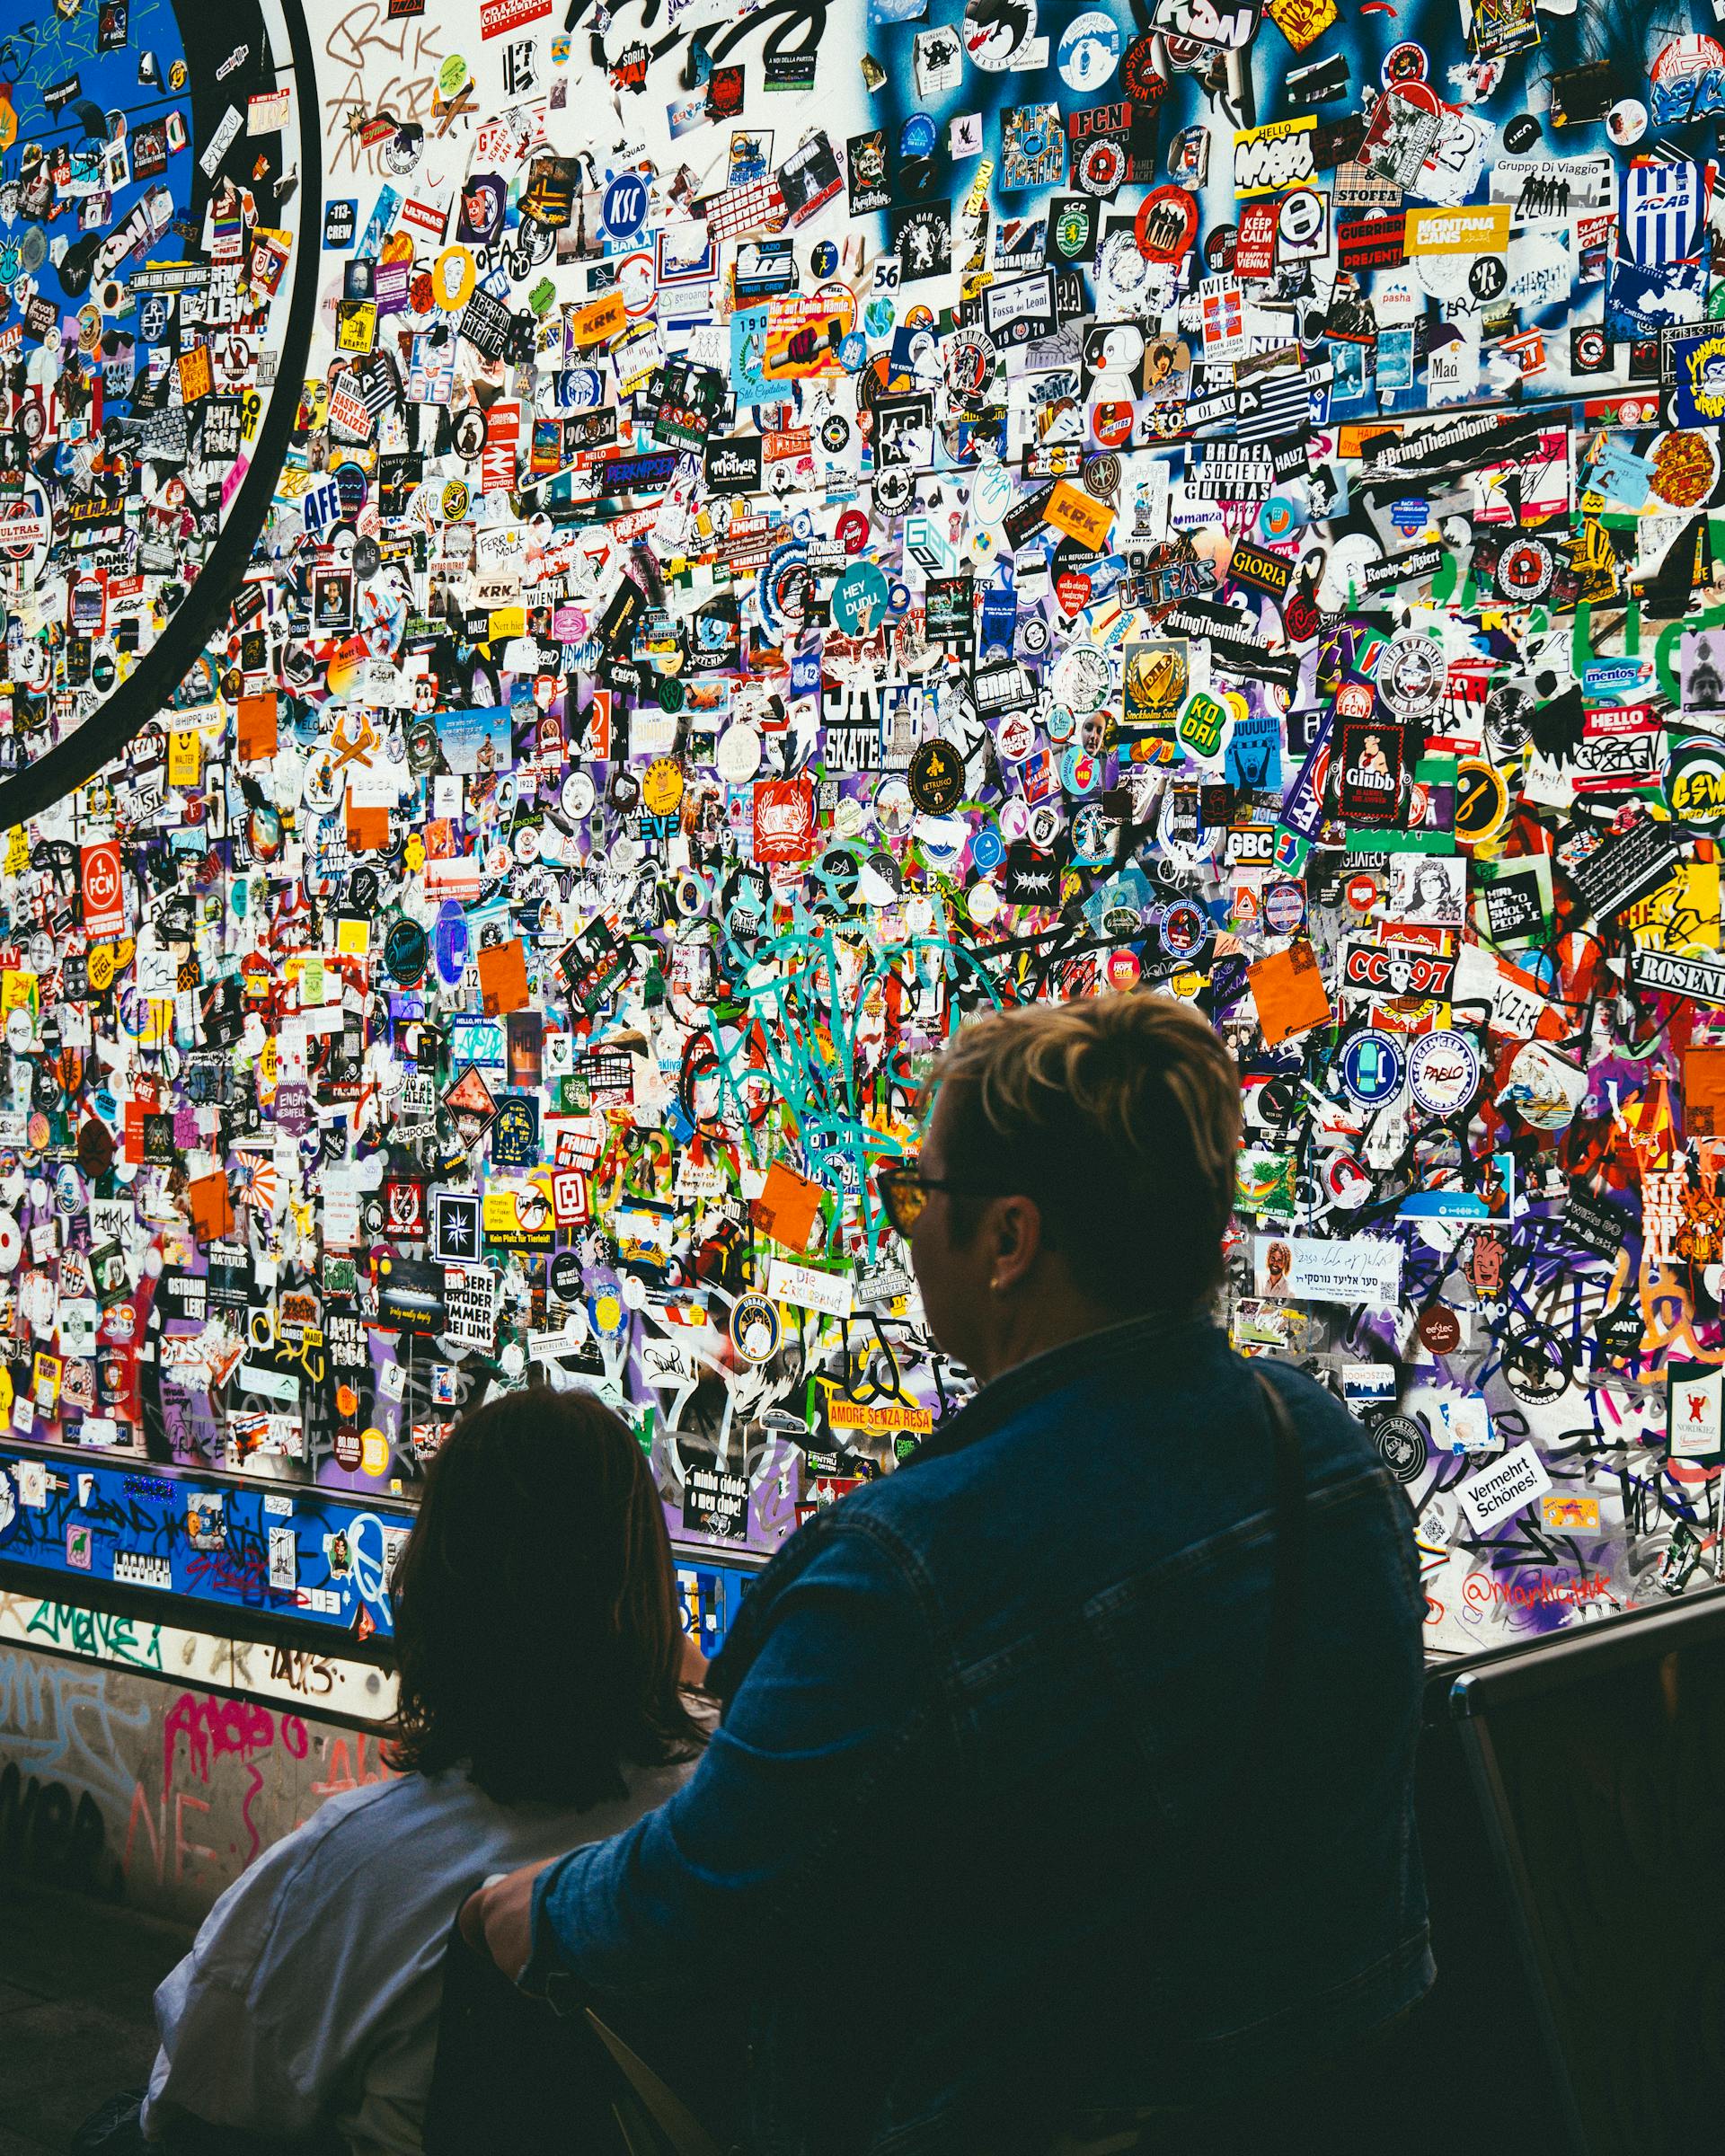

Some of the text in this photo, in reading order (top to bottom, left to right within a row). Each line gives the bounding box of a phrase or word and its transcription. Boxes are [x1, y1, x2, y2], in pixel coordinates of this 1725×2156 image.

[623, 52, 646, 67] SORIA
[1078, 105, 1123, 134] FCN
[1259, 124, 1291, 138] HELLO
[488, 128, 509, 162] SCHEISS
[499, 143, 512, 163] GAK
[622, 144, 646, 159] SQUAD
[54, 167, 69, 183] 1985
[1498, 161, 1598, 174] Gruppo Di Viaggio
[1339, 190, 1397, 201] STOFFA
[1634, 195, 1690, 212] ACAB
[610, 188, 641, 225] KSC
[1064, 202, 1086, 213] SCP
[404, 205, 444, 229] ULTRAS
[1243, 216, 1272, 231] KEEP
[1417, 216, 1495, 233] MONTANA
[327, 225, 352, 240] CREW
[1240, 228, 1272, 243] CALM
[1416, 231, 1461, 245] CANS
[761, 243, 781, 252] LAZIO
[1210, 252, 1224, 269] 90
[1237, 259, 1269, 269] VIENNA
[1343, 249, 1402, 268] PRESENTI
[875, 265, 898, 288] 56
[209, 282, 236, 297] AUS
[742, 282, 784, 293] TIBUR CREW
[1203, 276, 1239, 296] WIEN
[675, 288, 707, 304] genoano
[1383, 293, 1411, 304] pasha
[206, 296, 243, 323] LEV
[769, 299, 851, 314] Hör auf Deine Hände.
[992, 299, 1014, 319] Fossa
[1026, 295, 1048, 310] Leoni
[582, 308, 617, 335] KRK
[998, 323, 1045, 346] 19 70
[1207, 339, 1243, 352] GEGEN JEDEN
[568, 389, 596, 399] HJK
[331, 405, 369, 434] POLIZEI
[205, 429, 237, 453] 1964
[1377, 411, 1499, 459] #BringThemHome
[585, 450, 606, 461] HELLO
[721, 450, 737, 460] The
[1206, 444, 1272, 461] BROKEN
[1275, 447, 1305, 473] HAUZ
[711, 458, 756, 476] Mother
[1204, 463, 1271, 480] SOCIETY
[483, 479, 514, 488] awaydays
[1202, 482, 1270, 499] ULTRAS
[303, 482, 341, 531] AFE
[1057, 499, 1101, 534] KRK
[1184, 510, 1222, 524] manza
[1, 525, 40, 537] ULTRAS
[732, 518, 767, 534] IMMER
[383, 541, 411, 552] ESSENER
[495, 543, 525, 560] MOLA
[808, 543, 846, 557] ATOMISER
[96, 553, 129, 566] DANK
[1068, 553, 1093, 561] REFUGEES
[430, 561, 464, 571] RYTAS ULTRAS
[1233, 552, 1286, 587] GLORIA
[119, 579, 136, 588] HELLO
[479, 584, 512, 598] KRK
[843, 579, 865, 601] HEY
[526, 592, 553, 605] WIEN
[845, 591, 880, 614] DUDU.
[467, 619, 487, 634] HAUZ
[494, 621, 524, 632] Nett hier
[1588, 667, 1635, 681] mentos
[1191, 698, 1219, 720] KO
[1344, 704, 1363, 714] FCN
[1590, 711, 1644, 728] HELLO
[1003, 733, 1032, 747] ALPINE
[1182, 720, 1217, 748] DAI
[1003, 743, 1031, 755] FOOLS
[174, 754, 194, 764] WALTER
[1077, 771, 1090, 780] HB
[1347, 767, 1395, 791] Glubb
[519, 780, 534, 788] 1922
[11, 834, 26, 843] THE
[1228, 833, 1273, 858] GBC
[97, 862, 106, 875] 1.
[90, 876, 115, 894] FCN
[1489, 898, 1508, 911] ME
[87, 922, 124, 935] VEREIN
[731, 915, 758, 932] PLANET
[93, 964, 112, 982] FIGL
[1113, 963, 1133, 971] HOPE
[1349, 950, 1452, 993] CC 97
[466, 968, 478, 987] 12
[1423, 1065, 1464, 1082] PABLO
[136, 1086, 155, 1098] ART
[405, 1078, 431, 1092] TO BE
[404, 1091, 432, 1105] HERE
[397, 1125, 436, 1140] SHPOCK
[558, 1153, 594, 1170] ON TOUR
[490, 1234, 551, 1243] Kein Platz für Tierleid!
[210, 1255, 247, 1268] NATUUR
[796, 1268, 817, 1287] Die
[167, 1278, 206, 1297] OSTBAHN
[184, 1298, 206, 1320] LEBT
[743, 1299, 766, 1310] URBAN
[281, 1325, 322, 1345] BARBER MADE
[331, 1345, 367, 1367] 1964
[1513, 1387, 1559, 1405] GAVROCHE
[830, 1404, 930, 1429] AMORE SENZA RESA
[1390, 1420, 1419, 1441] SEKTION
[1676, 1423, 1716, 1435] NORDKIEZ
[338, 1436, 359, 1448] 80.000
[694, 1471, 748, 1500] minha cidade,
[1468, 1457, 1530, 1502] Vermehrt
[1476, 1471, 1538, 1518] Schönes!
[690, 1492, 742, 1517] o meu clube!
